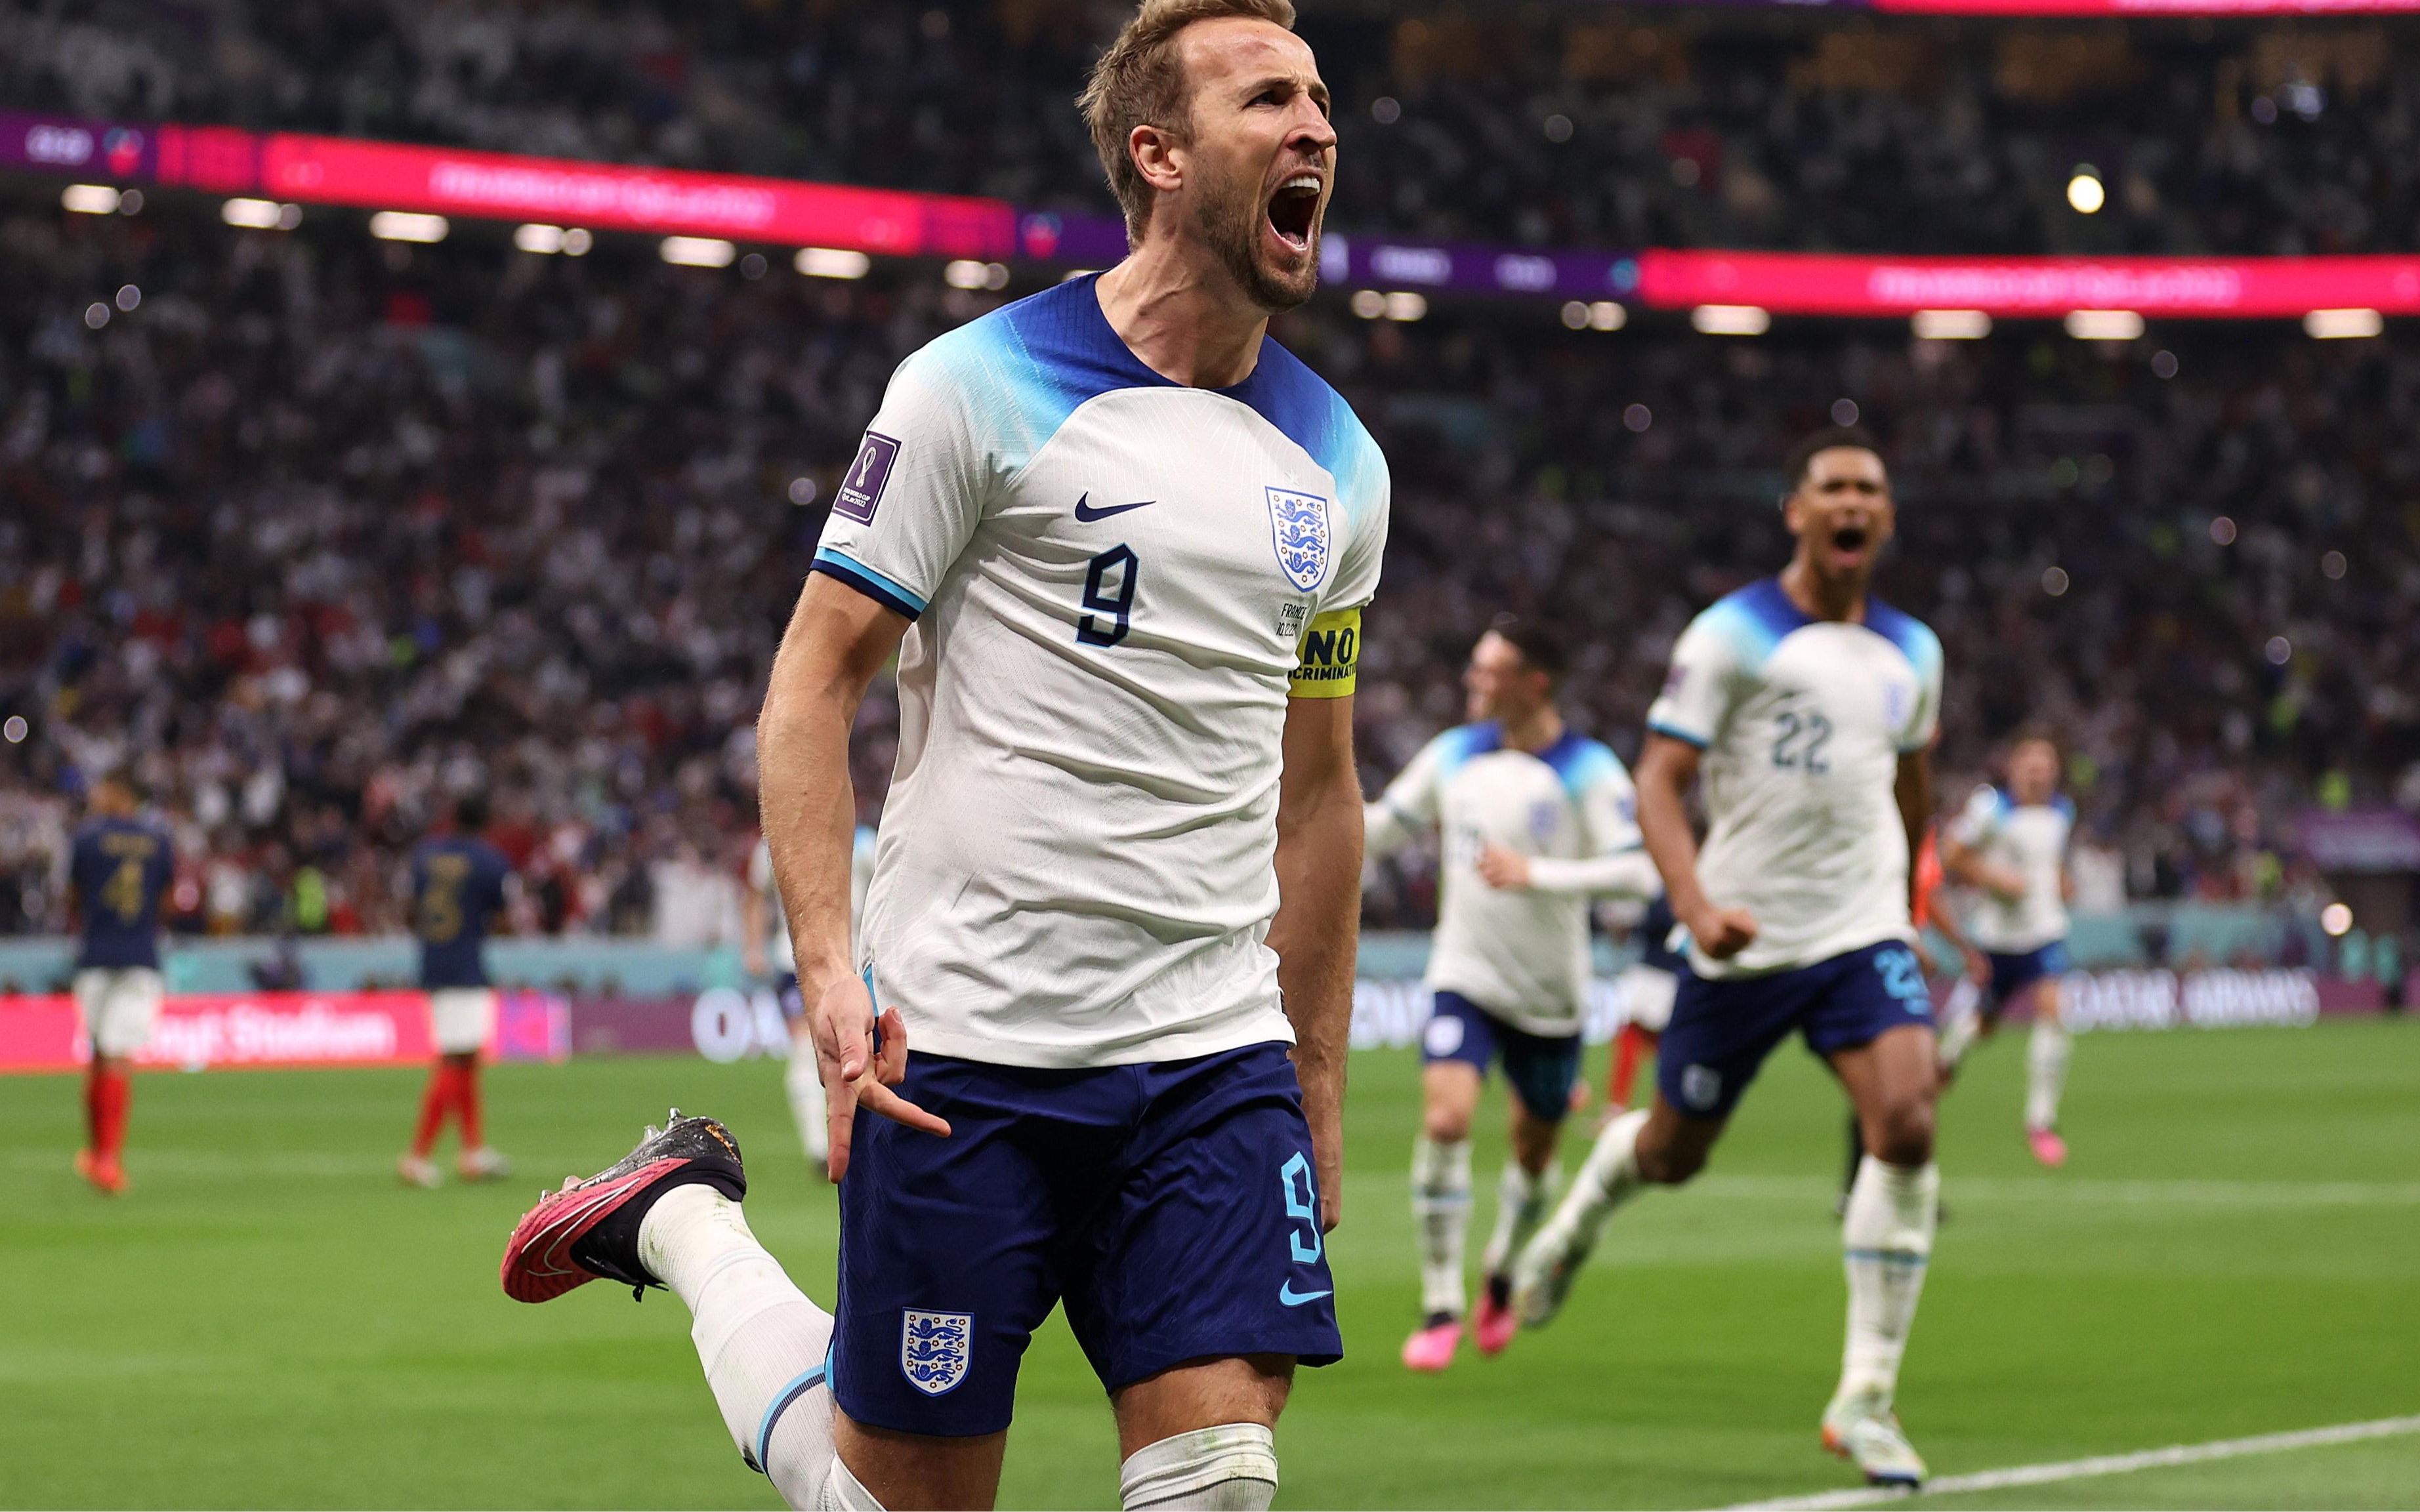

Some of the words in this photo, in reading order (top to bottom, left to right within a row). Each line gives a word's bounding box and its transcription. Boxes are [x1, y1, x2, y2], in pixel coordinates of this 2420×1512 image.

[1075, 541, 1140, 649] 9
[1281, 603, 1307, 620] FRANCE
[1303, 628, 1354, 665] NO
[1773, 712, 1831, 774] 22
[1281, 1151, 1322, 1265] 9
